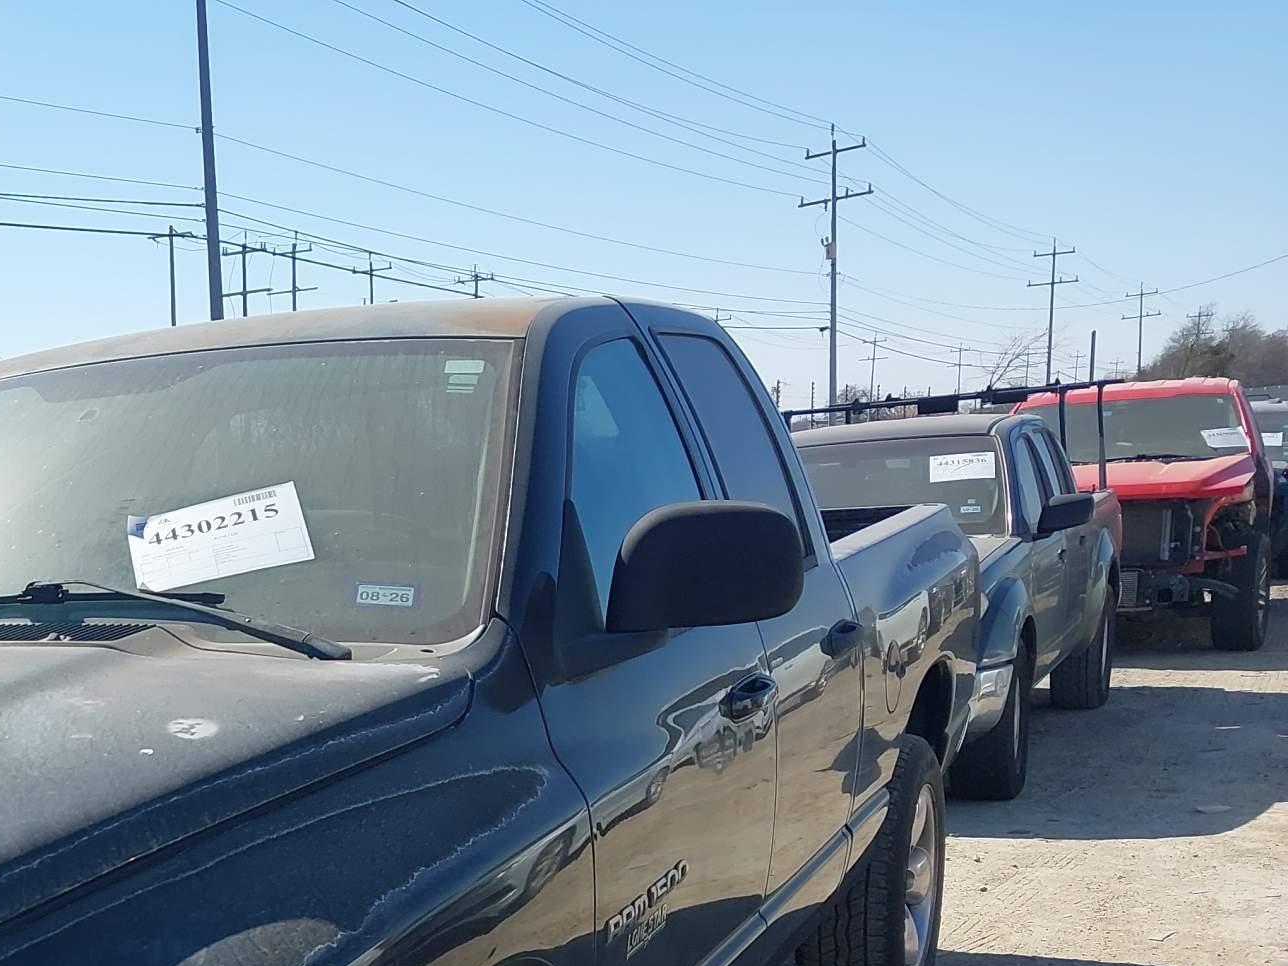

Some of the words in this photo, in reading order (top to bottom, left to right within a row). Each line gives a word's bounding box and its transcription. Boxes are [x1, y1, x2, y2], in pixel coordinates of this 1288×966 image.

[148, 503, 280, 545] 44302215
[606, 894, 649, 945] RAM
[648, 859, 689, 908] 1500
[647, 903, 668, 934] STAR
